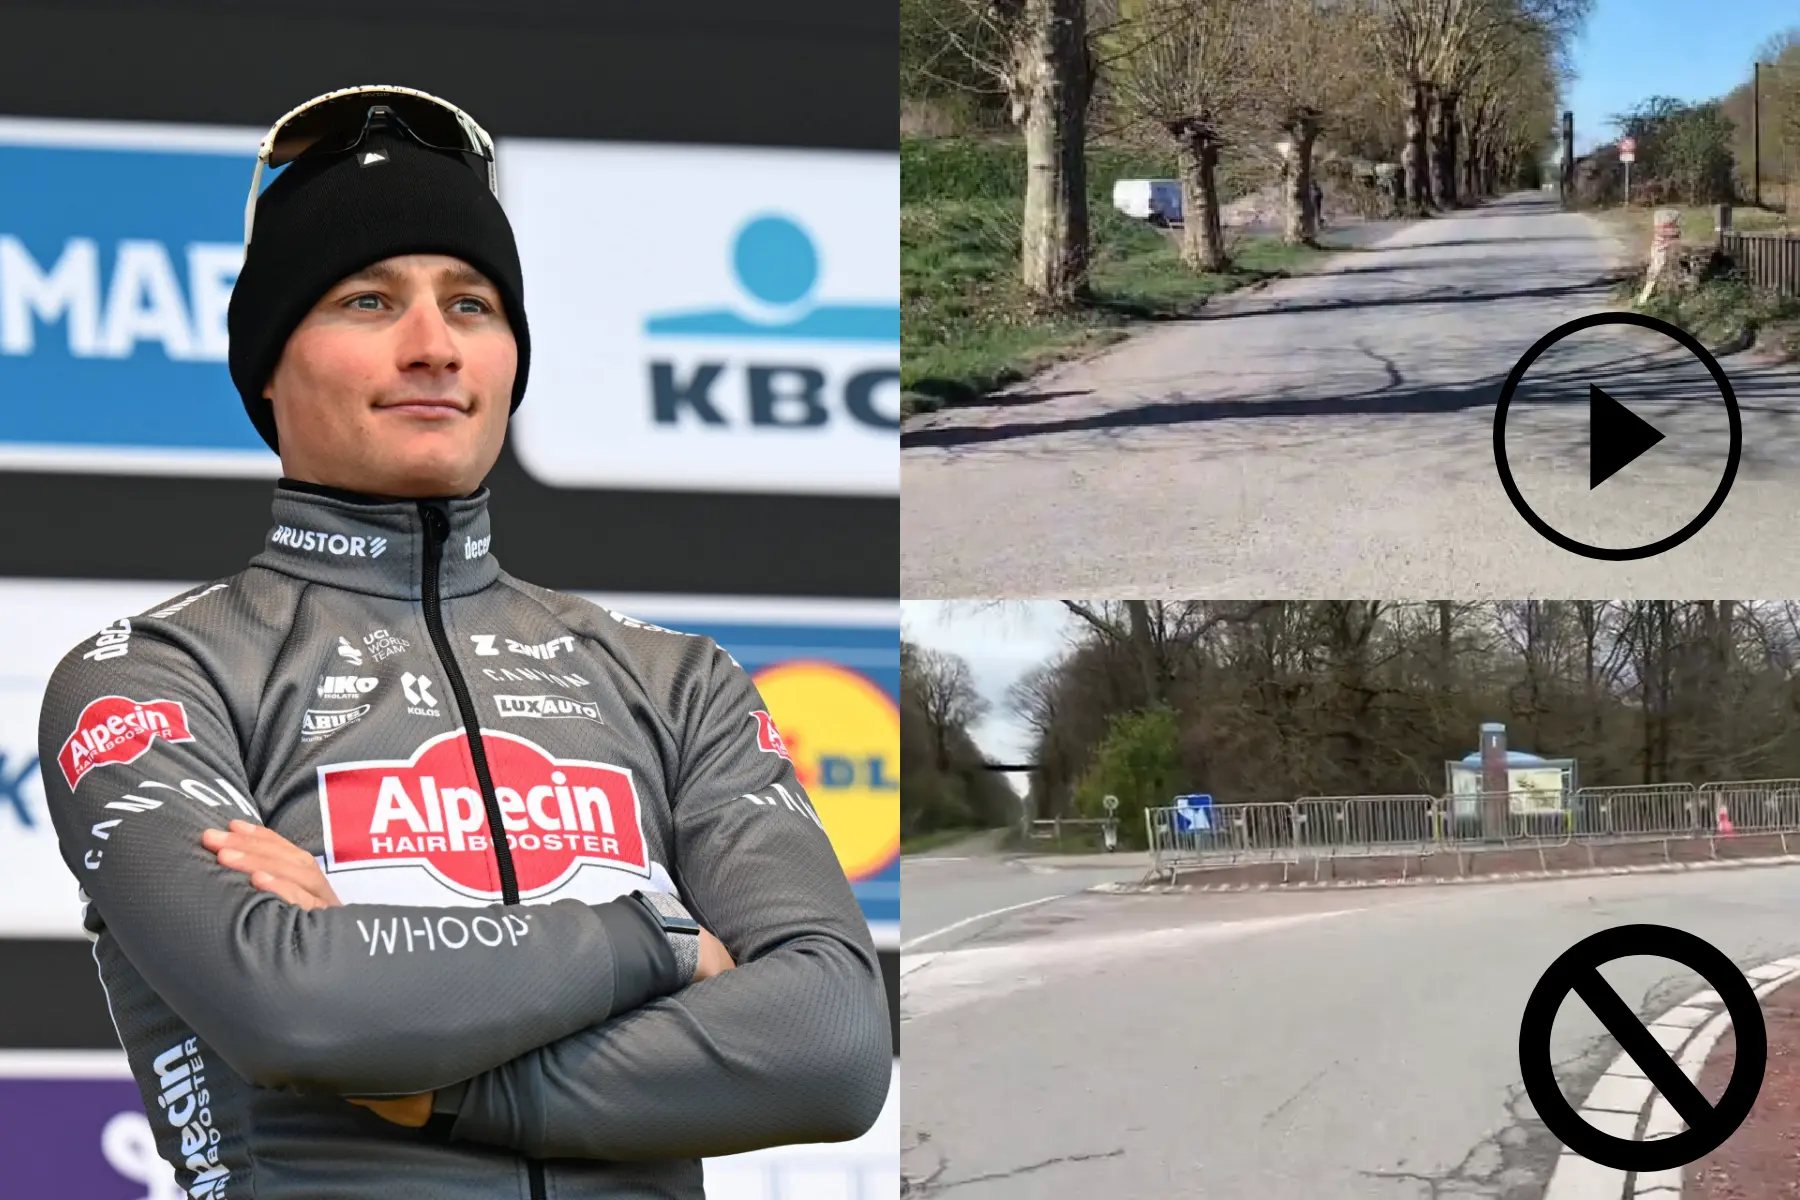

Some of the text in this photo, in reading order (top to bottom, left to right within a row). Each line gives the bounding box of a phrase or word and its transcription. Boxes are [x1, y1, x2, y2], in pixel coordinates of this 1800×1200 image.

[271, 525, 366, 557] BRUSTOR
[363, 629, 389, 645] UCI
[367, 636, 410, 654] WORLD
[505, 636, 575, 660] ZWIFT
[372, 645, 406, 663] TEAM
[324, 676, 379, 693] IKO
[482, 667, 590, 688] CANYON
[70, 705, 171, 768] Alpecin
[369, 771, 615, 852] Alpecin
[371, 836, 447, 853] HAIR
[356, 915, 529, 956] WHOOP
[184, 1036, 221, 1165] BOOSTER
